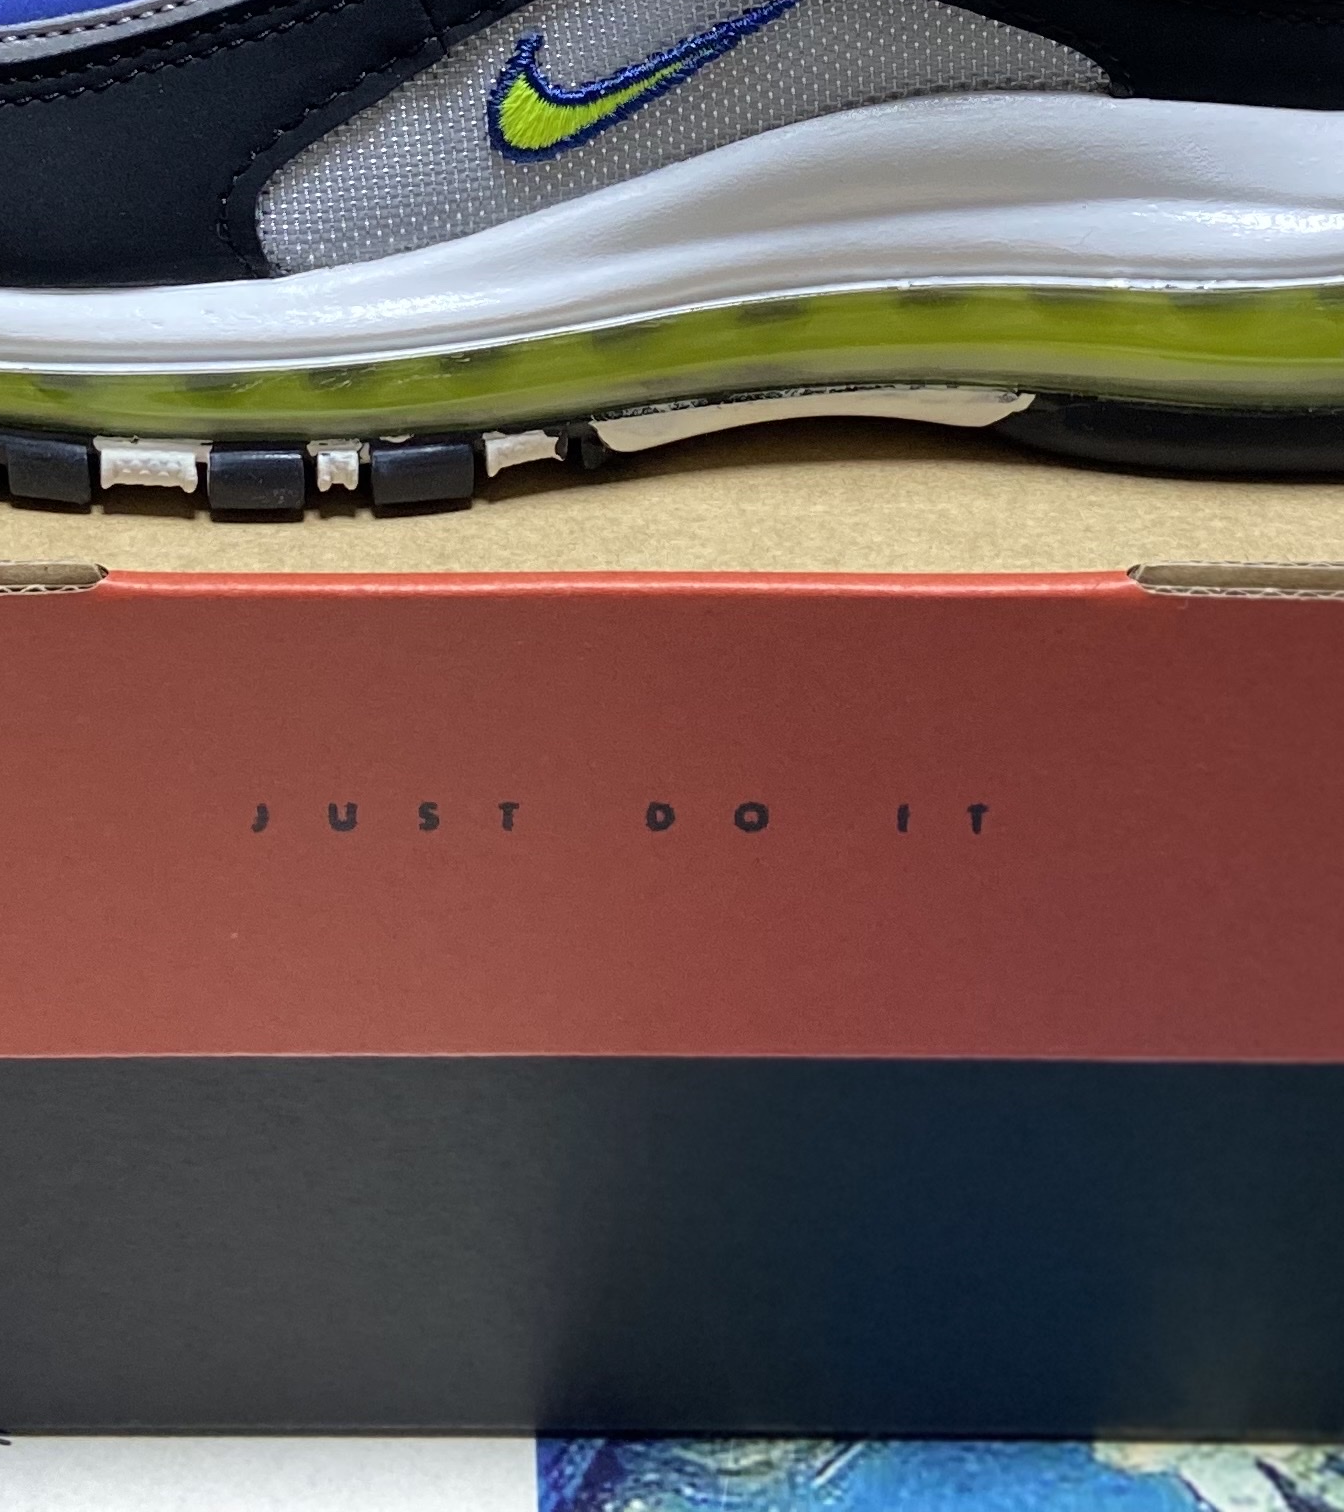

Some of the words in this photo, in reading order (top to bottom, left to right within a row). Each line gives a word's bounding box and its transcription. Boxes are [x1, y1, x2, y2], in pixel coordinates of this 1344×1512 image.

[249, 800, 521, 835] JUST
[644, 800, 771, 835] DO
[895, 801, 990, 836] IT
